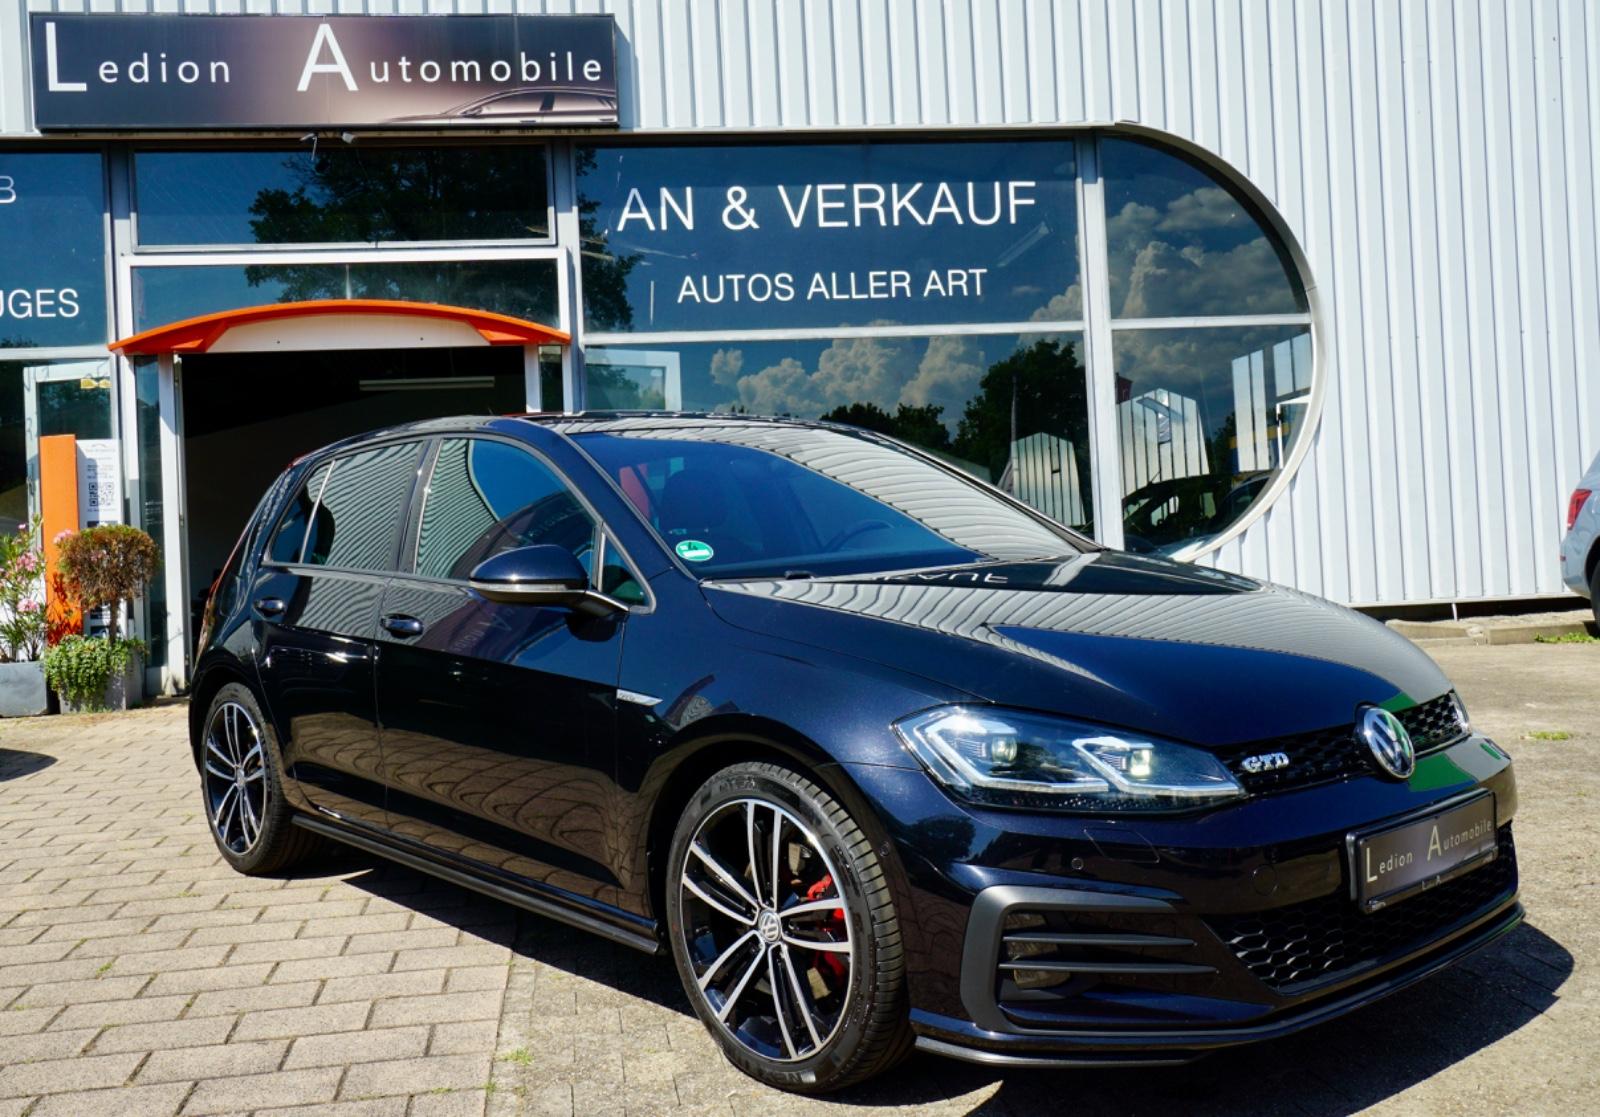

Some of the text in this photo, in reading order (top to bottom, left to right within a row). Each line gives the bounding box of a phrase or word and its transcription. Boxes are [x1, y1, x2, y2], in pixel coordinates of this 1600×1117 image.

[45, 22, 602, 92] Ledion Automobile
[616, 180, 1037, 232] AN & VERKAUF
[0, 287, 80, 319] GES
[677, 268, 988, 305] AUTOS ALLER ART
[1241, 751, 1290, 774] GTD
[1366, 847, 1413, 884] Ledion
[1427, 818, 1492, 862] Automobile
